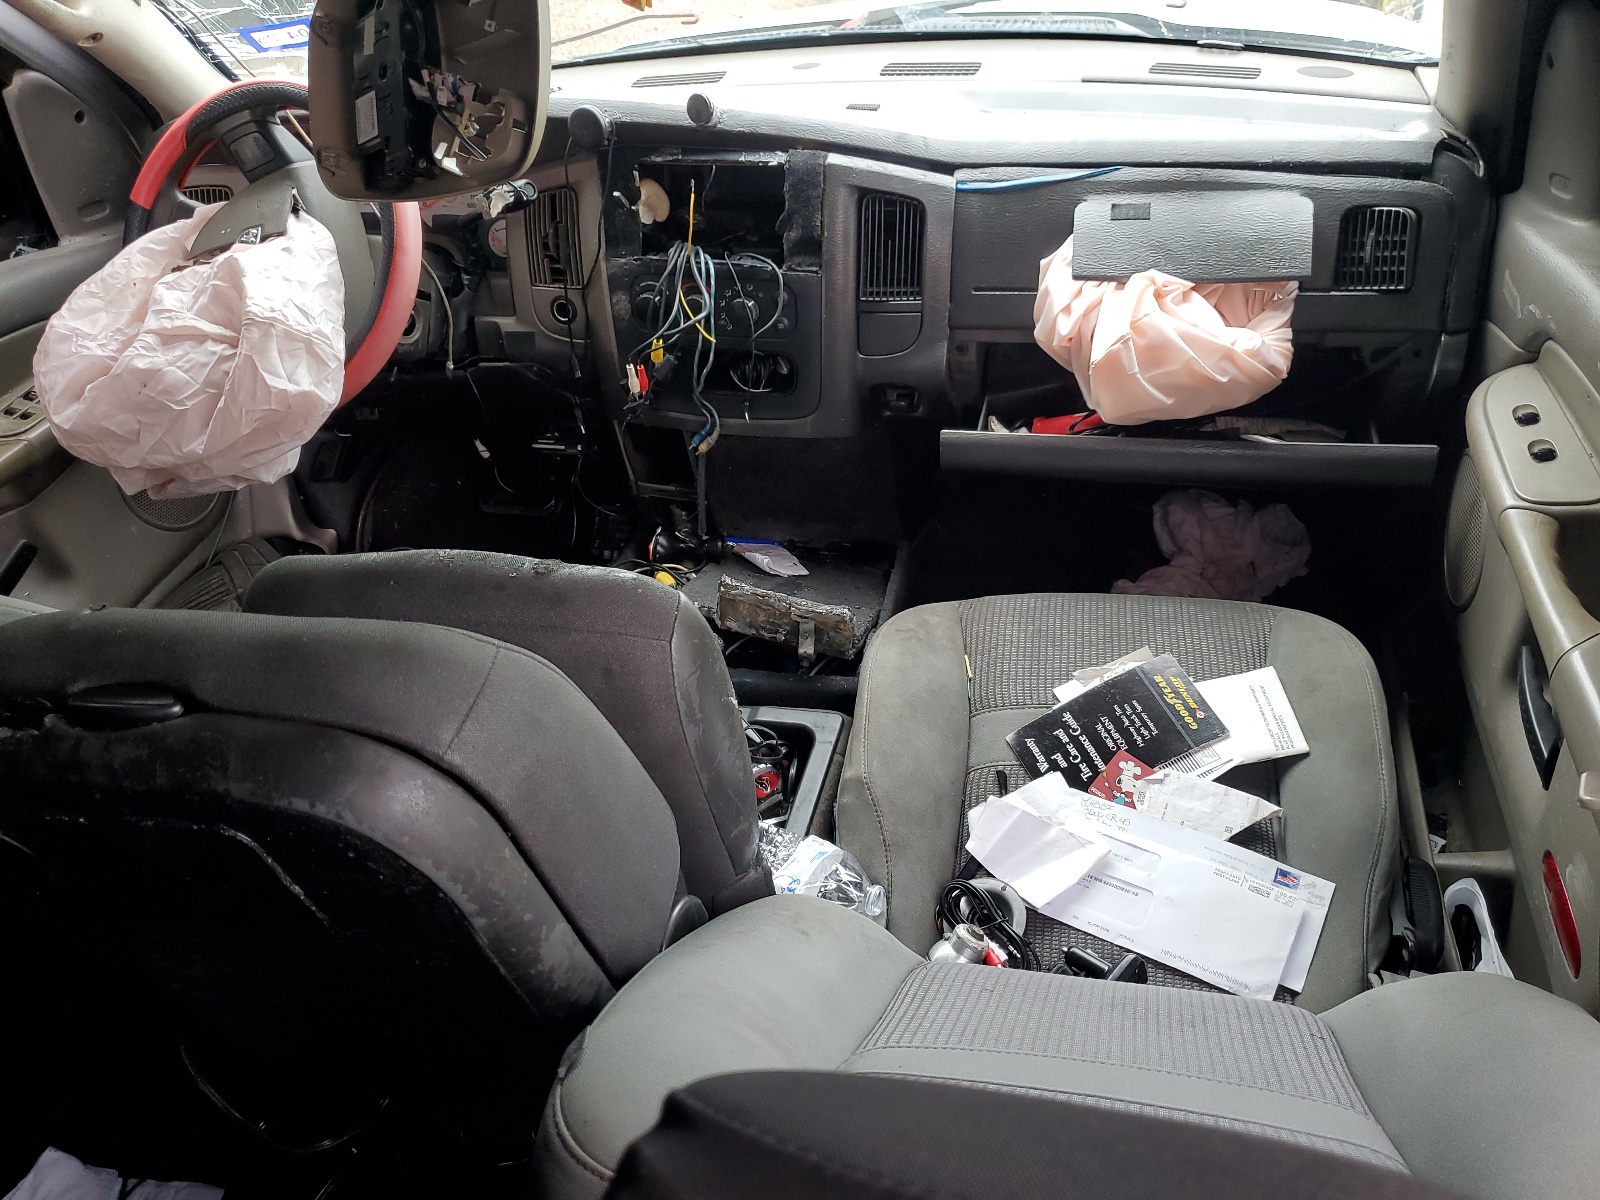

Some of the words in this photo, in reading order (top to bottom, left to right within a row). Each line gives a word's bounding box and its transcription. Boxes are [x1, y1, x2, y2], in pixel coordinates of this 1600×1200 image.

[1153, 673, 1198, 730] GOODYEAR
[1169, 676, 1198, 709] DUNLOP
[1113, 704, 1122, 717] Tires
[1123, 704, 1132, 715] Tires
[1132, 699, 1143, 712] Spare
[1062, 711, 1081, 735] Guide
[1120, 715, 1131, 728] Auto
[1130, 714, 1142, 728] Truck
[1142, 711, 1159, 736] Temporary
[1053, 728, 1070, 744] and
[1095, 722, 1117, 751] ORIGINAL
[1100, 716, 1128, 750] EQUIPMENT
[1128, 725, 1145, 748] Highway
[1140, 727, 1151, 740] Light
[1024, 738, 1050, 773] Warranty
[1051, 752, 1067, 768] and
[1066, 743, 1081, 763] Care
[1079, 735, 1107, 772] intenance
[1079, 762, 1093, 782] Tire
